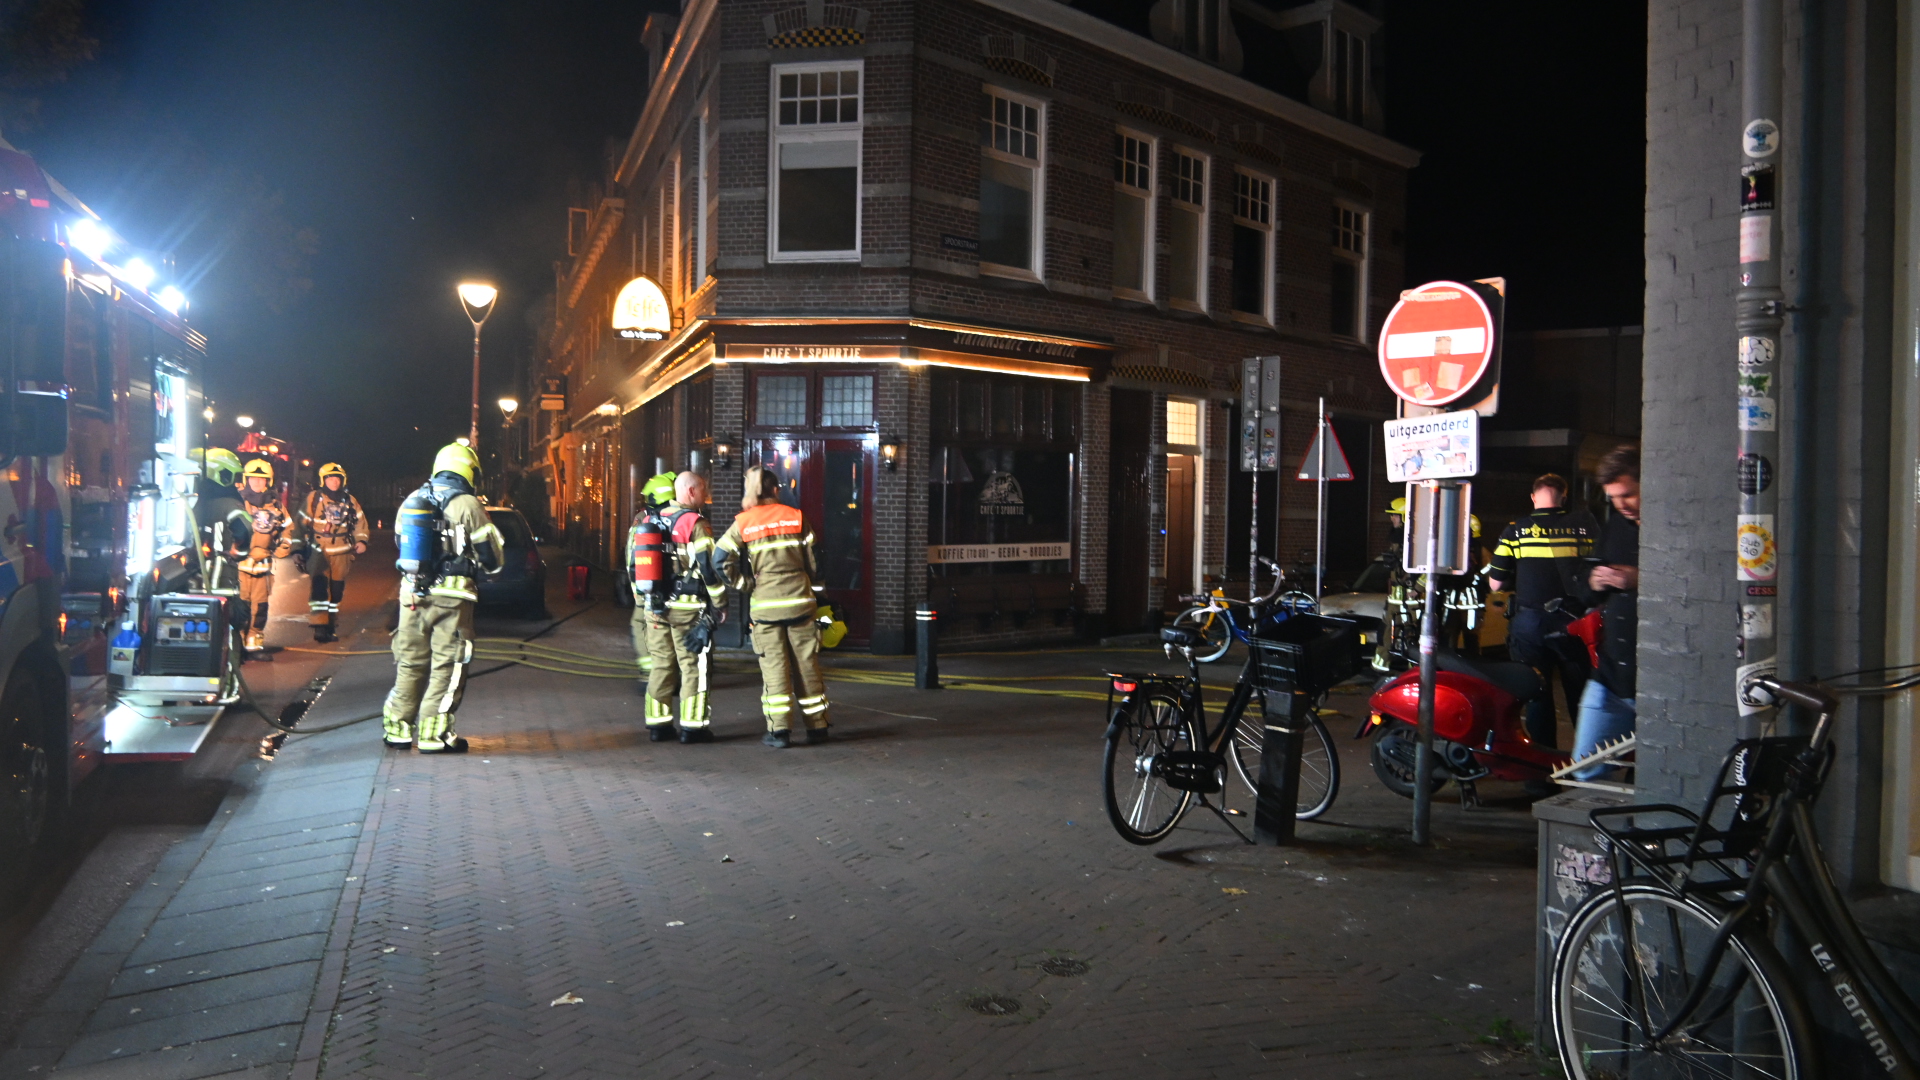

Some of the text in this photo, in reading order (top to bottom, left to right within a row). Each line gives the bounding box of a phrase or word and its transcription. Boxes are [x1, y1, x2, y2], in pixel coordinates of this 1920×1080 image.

[808, 347, 861, 359] SPOORTJE
[1389, 417, 1469, 440] uitgezonderd
[937, 547, 964, 560] KOFFIE
[998, 547, 1020, 558] GEBAK
[1030, 545, 1062, 557] BROODJES
